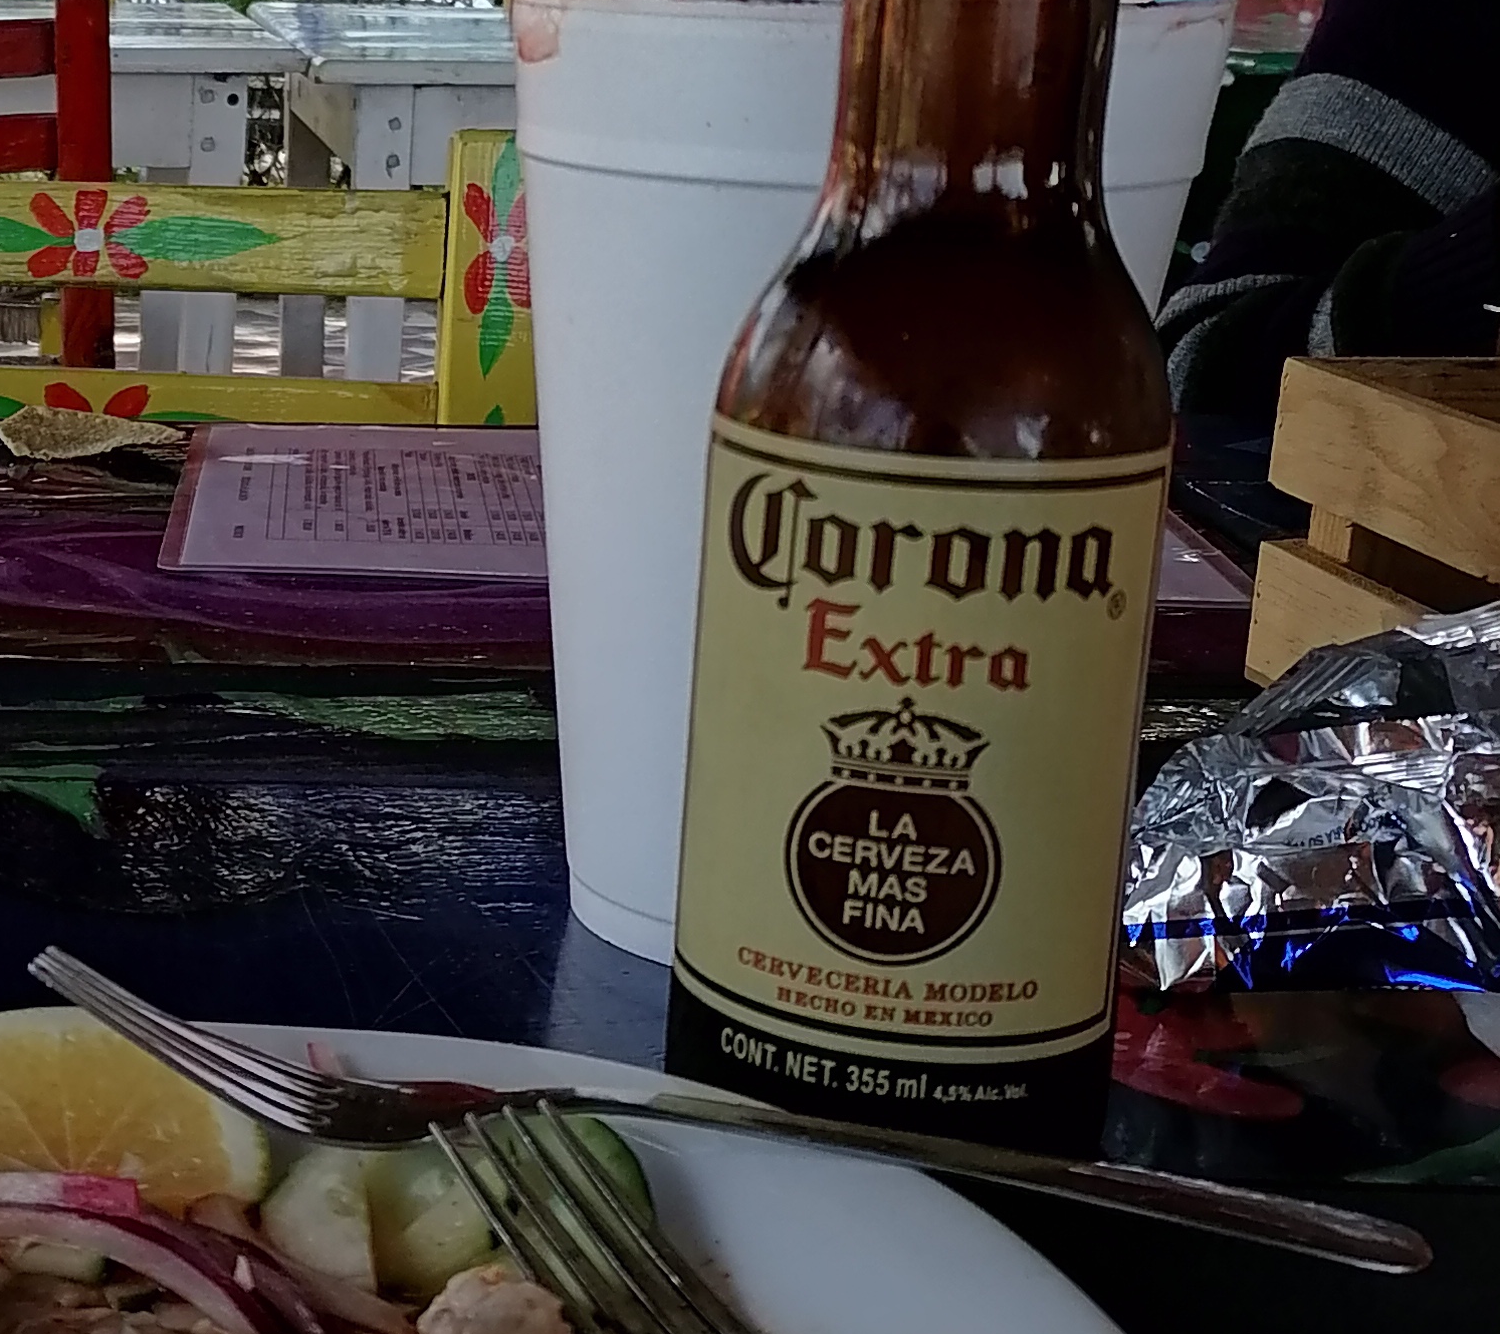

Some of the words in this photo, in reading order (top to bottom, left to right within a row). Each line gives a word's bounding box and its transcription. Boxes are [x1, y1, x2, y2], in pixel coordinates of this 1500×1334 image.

[729, 473, 1112, 610] Corona
[803, 597, 1031, 691] Extra
[869, 809, 917, 841] LA
[808, 831, 976, 876] CERVEZA
[848, 868, 928, 903] MAS
[842, 899, 925, 934] FINA
[737, 946, 912, 1000] CERVECERIA
[924, 980, 1038, 1003] MODELO
[777, 986, 856, 1016] HECHO
[864, 1005, 895, 1022] EN
[903, 1009, 993, 1028] MEXICO
[721, 1028, 778, 1073] CONT.
[786, 1051, 838, 1088] NET.
[846, 1066, 890, 1096] 355
[895, 1073, 927, 1099] ml
